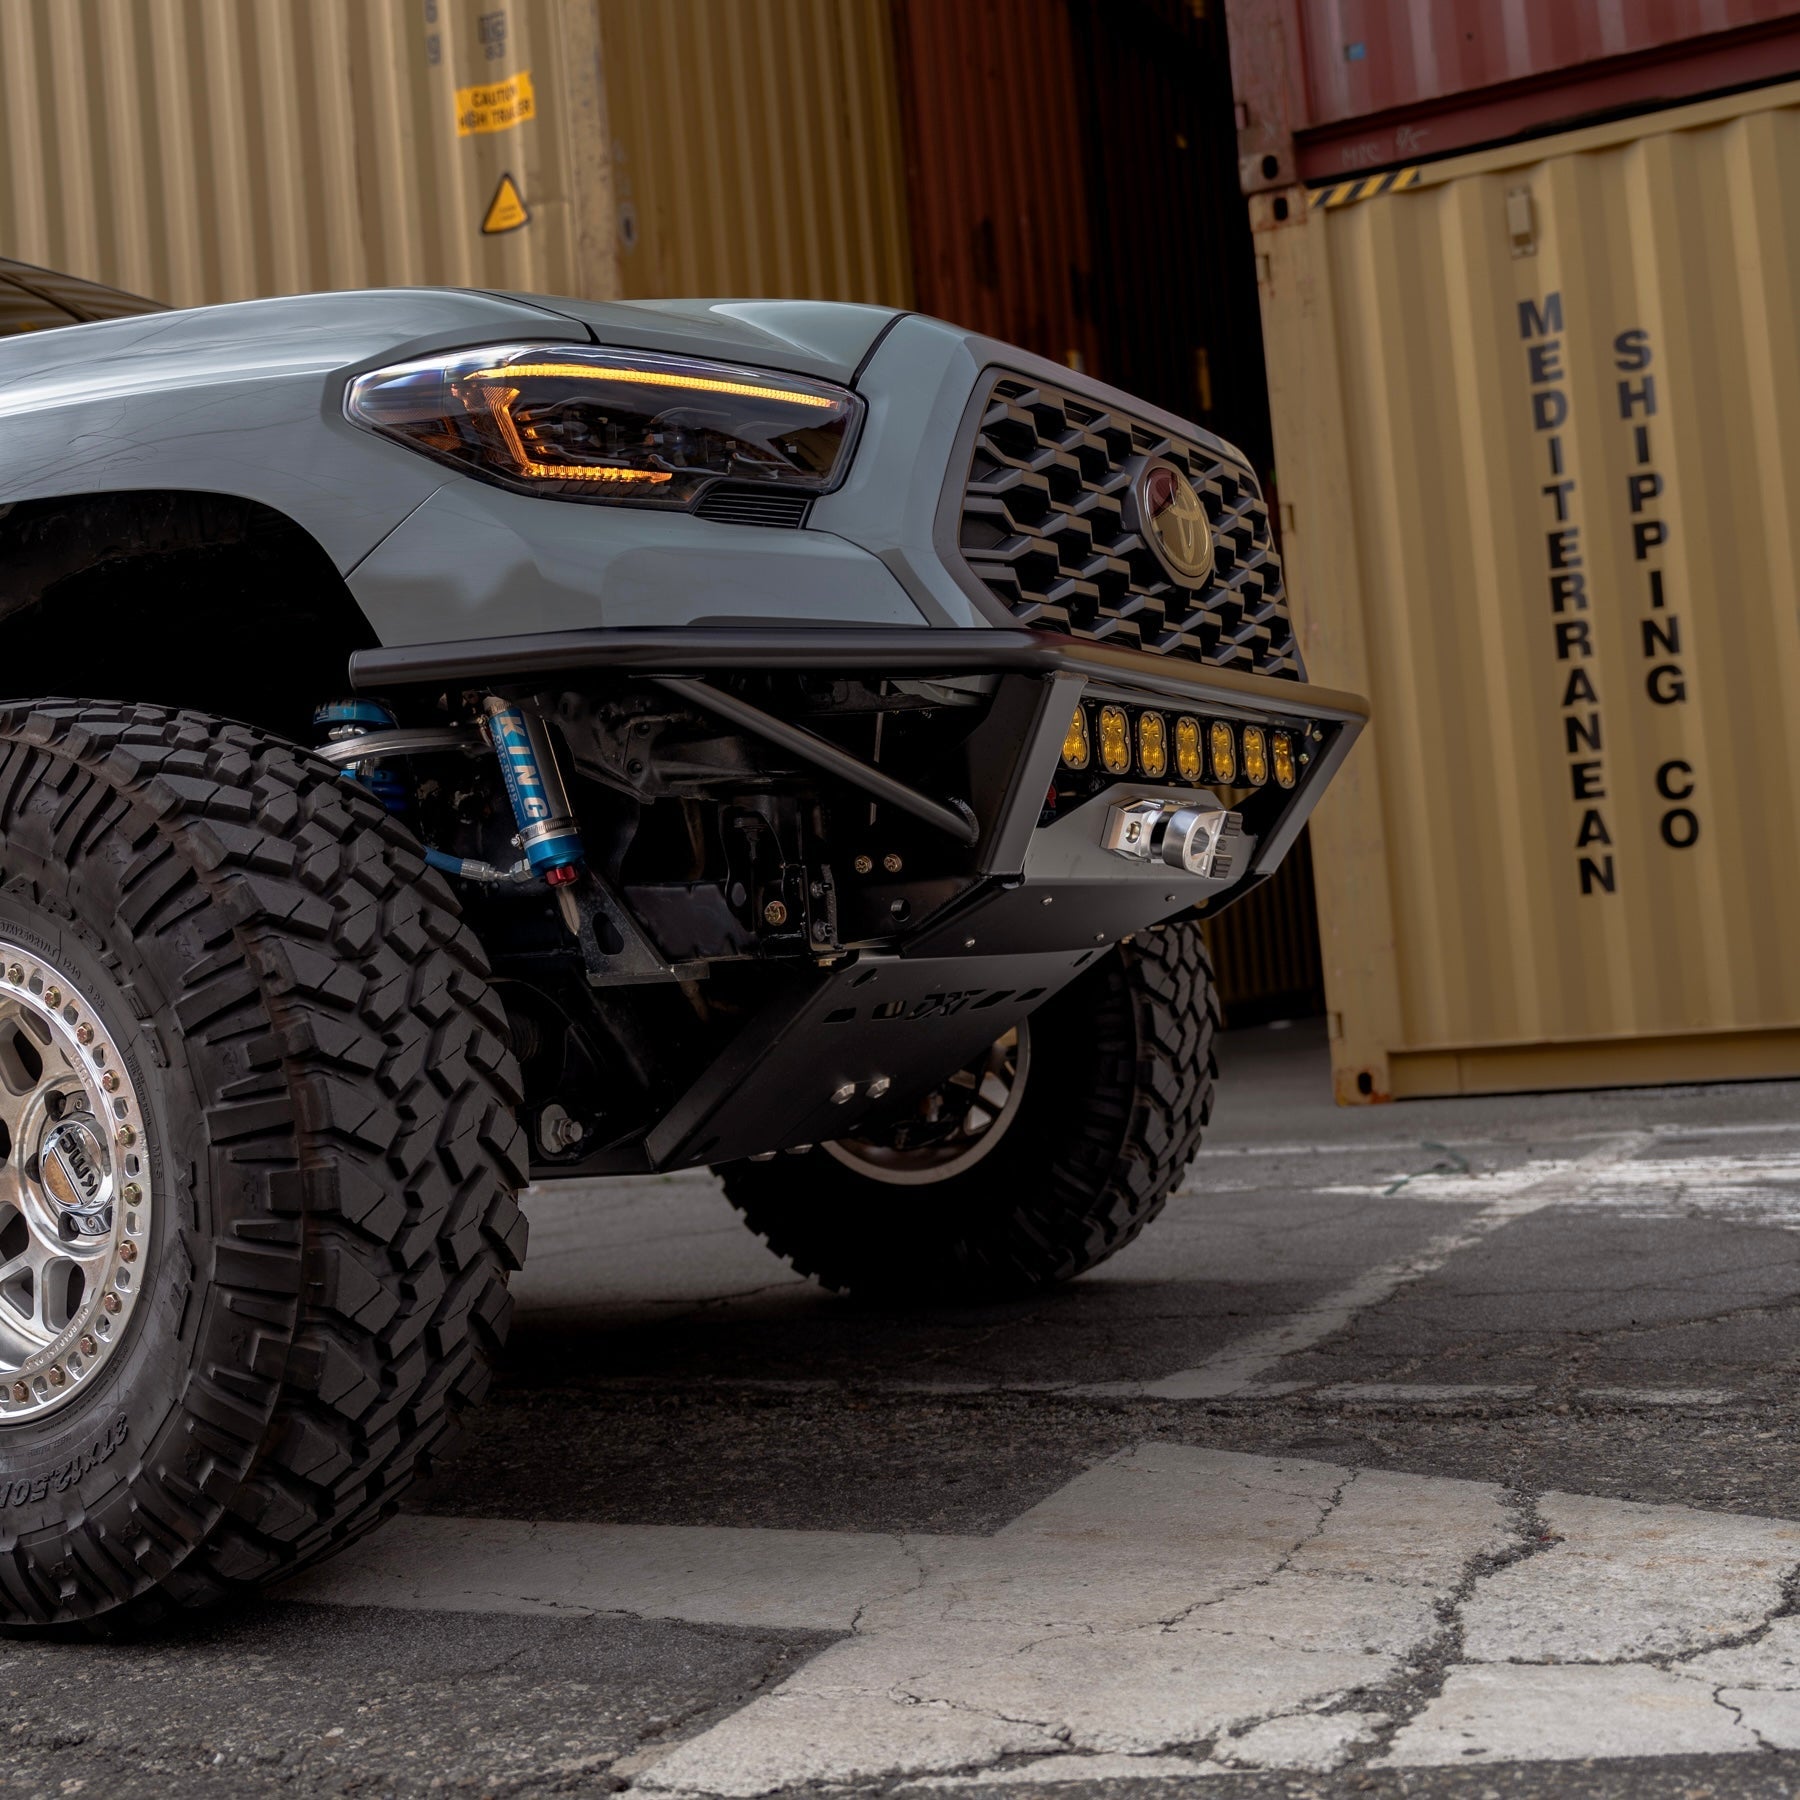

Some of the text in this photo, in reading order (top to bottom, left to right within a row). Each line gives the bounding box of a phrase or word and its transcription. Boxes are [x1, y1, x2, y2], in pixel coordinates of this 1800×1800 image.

[1517, 292, 1616, 895] MEDITERRANEAN
[1613, 329, 1700, 849] SHIPPING CO
[499, 715, 549, 819] KING
[0, 869, 171, 1069] APPLER
[59, 1132, 98, 1197] KMC
